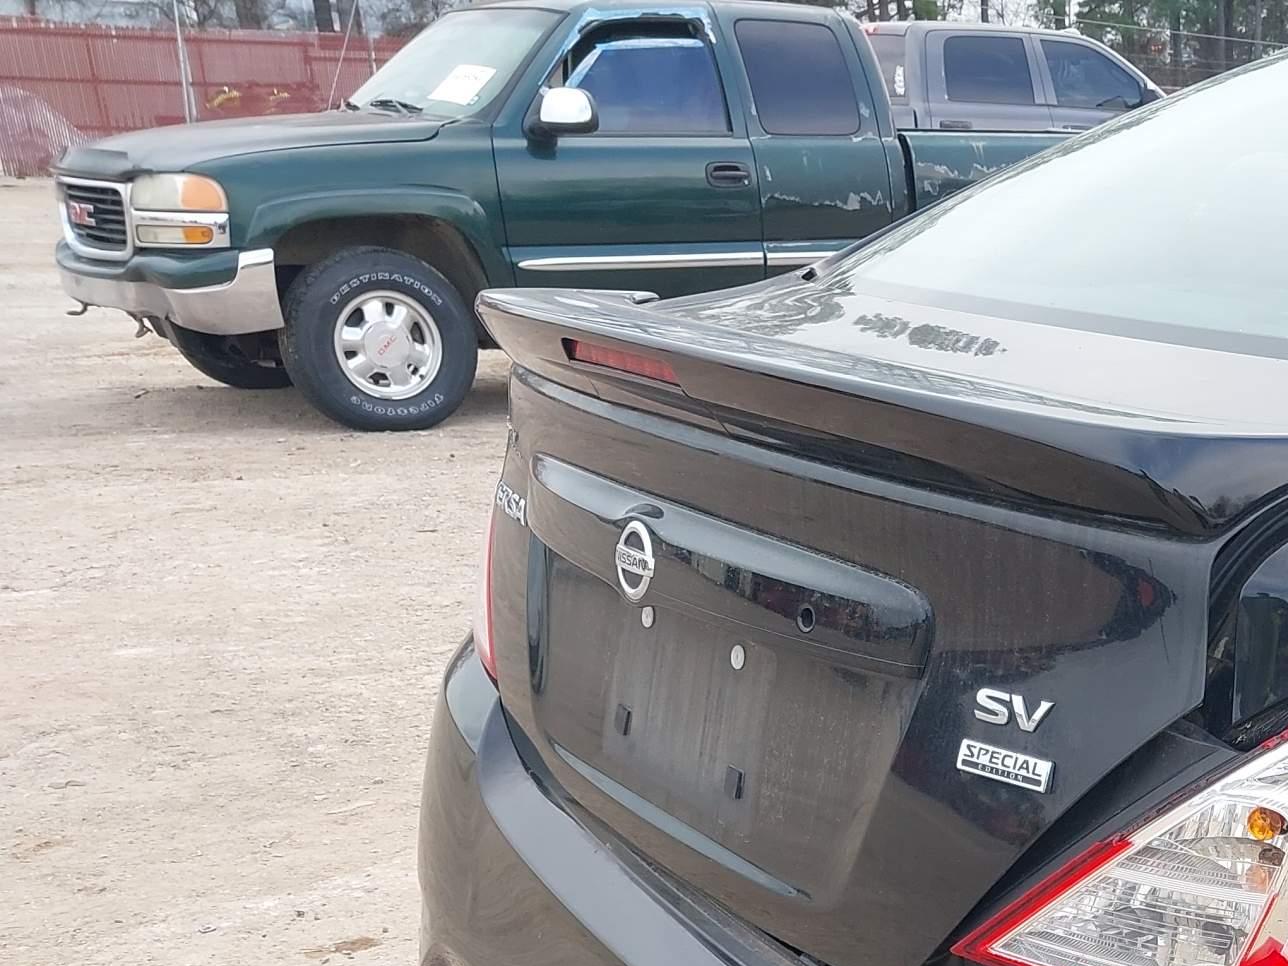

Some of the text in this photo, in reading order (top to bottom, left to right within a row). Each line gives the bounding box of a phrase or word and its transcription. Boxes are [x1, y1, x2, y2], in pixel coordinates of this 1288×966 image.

[330, 272, 442, 305] DESTINATION
[376, 335, 397, 356] GMC
[496, 481, 526, 526] ERSA
[616, 549, 650, 572] NISSAN
[973, 688, 1055, 732] SV
[963, 743, 1043, 778] SPECIAL
[978, 763, 1024, 784] EDITION
